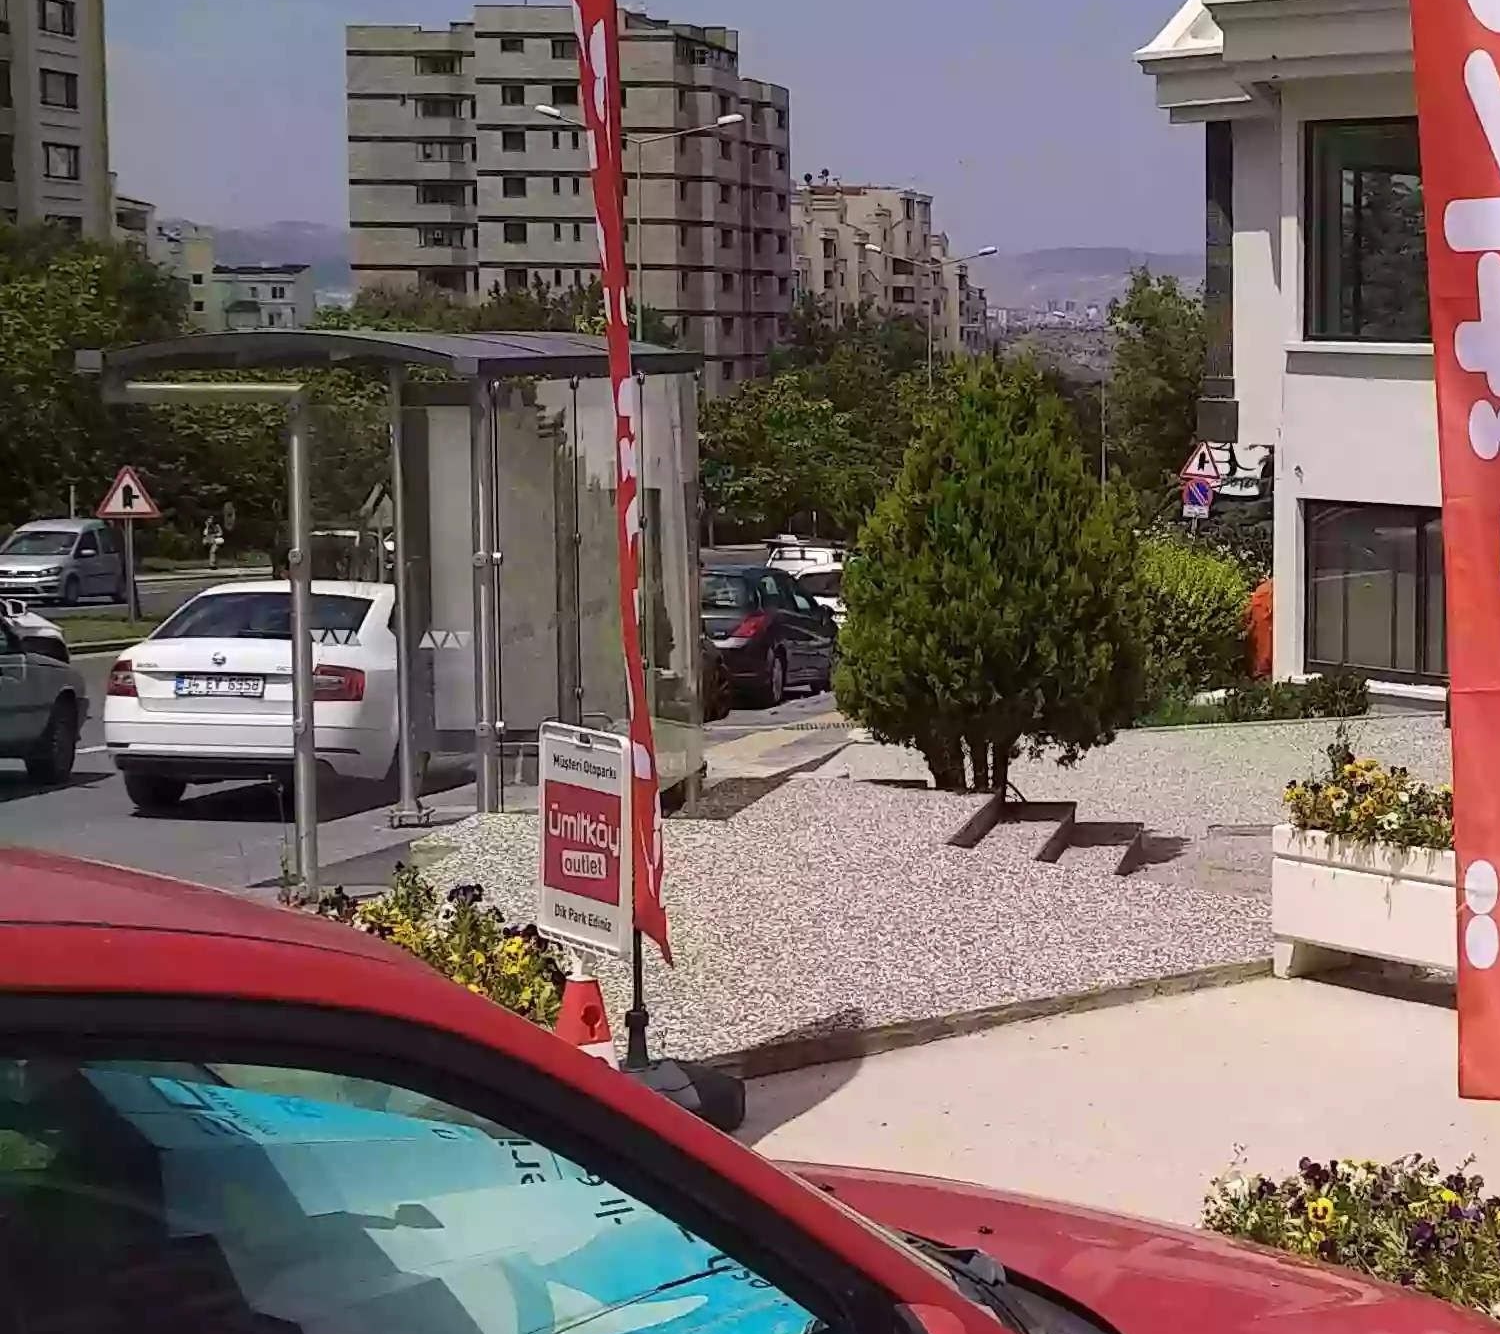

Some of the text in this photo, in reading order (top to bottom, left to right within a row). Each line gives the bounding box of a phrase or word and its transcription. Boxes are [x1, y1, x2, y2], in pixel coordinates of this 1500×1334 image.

[553, 754, 582, 772] Müşteri
[564, 855, 604, 876] outlet
[554, 903, 567, 920] Dik
[568, 908, 587, 925] Park
